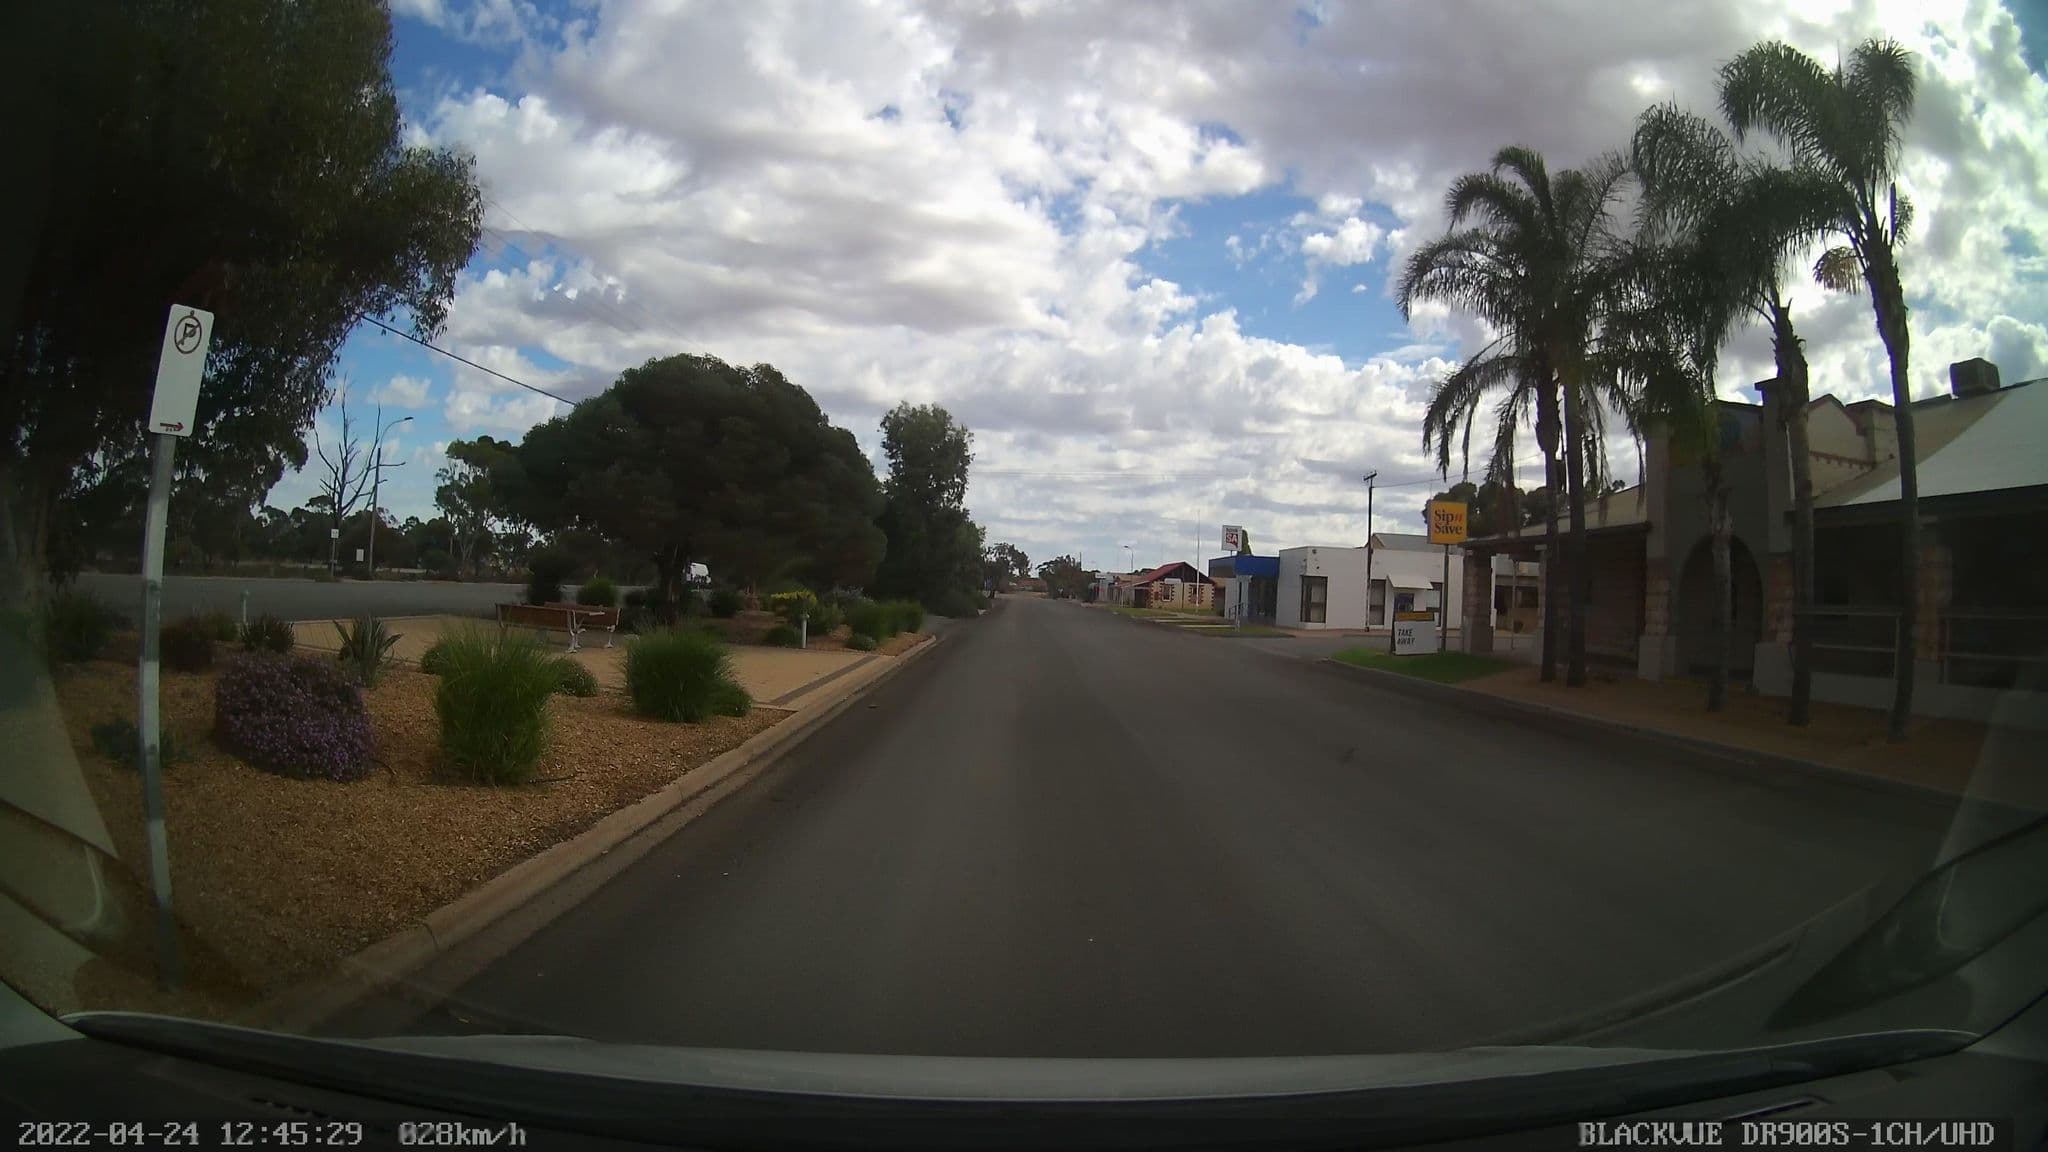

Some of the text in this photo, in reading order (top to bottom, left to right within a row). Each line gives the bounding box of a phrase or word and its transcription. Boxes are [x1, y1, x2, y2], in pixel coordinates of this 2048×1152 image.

[1434, 509, 1453, 525] Sip
[1434, 523, 1462, 535] Save
[1398, 629, 1413, 637] TAKE
[1397, 637, 1415, 645] AWAY
